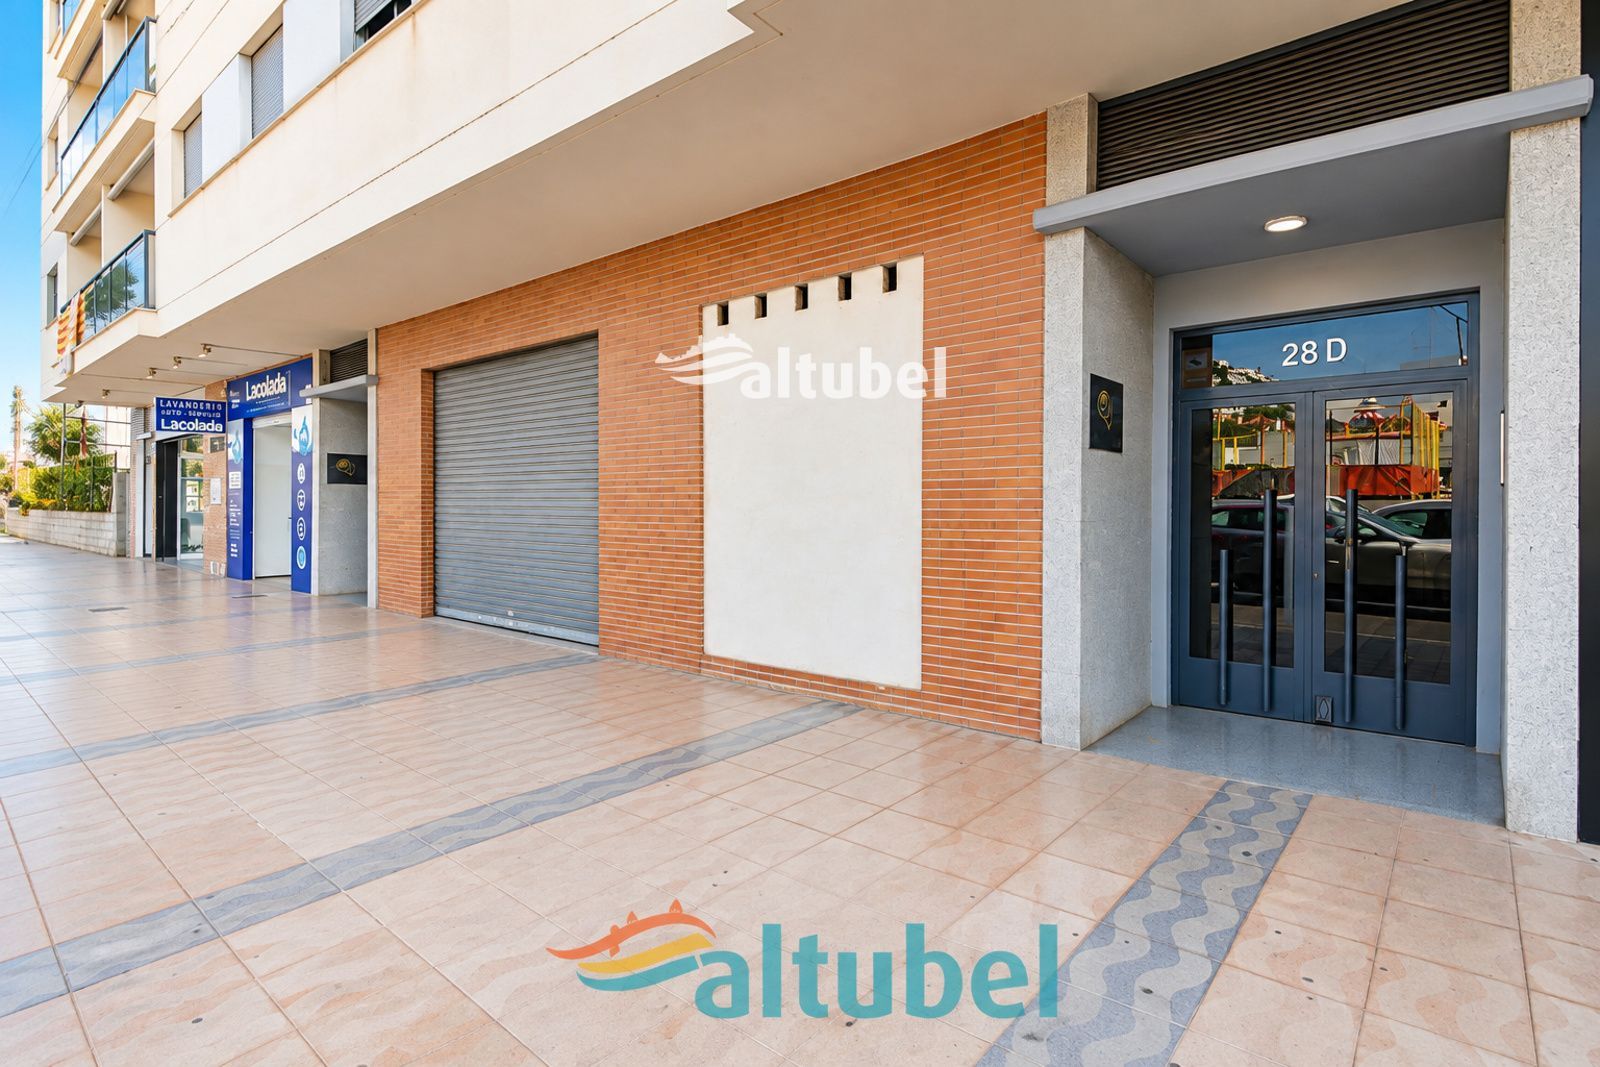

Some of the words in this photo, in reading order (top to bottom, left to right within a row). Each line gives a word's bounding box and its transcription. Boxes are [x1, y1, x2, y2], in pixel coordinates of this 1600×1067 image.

[1281, 340, 1319, 367] 28
[1326, 337, 1348, 363] D
[246, 372, 287, 402] Lacolada
